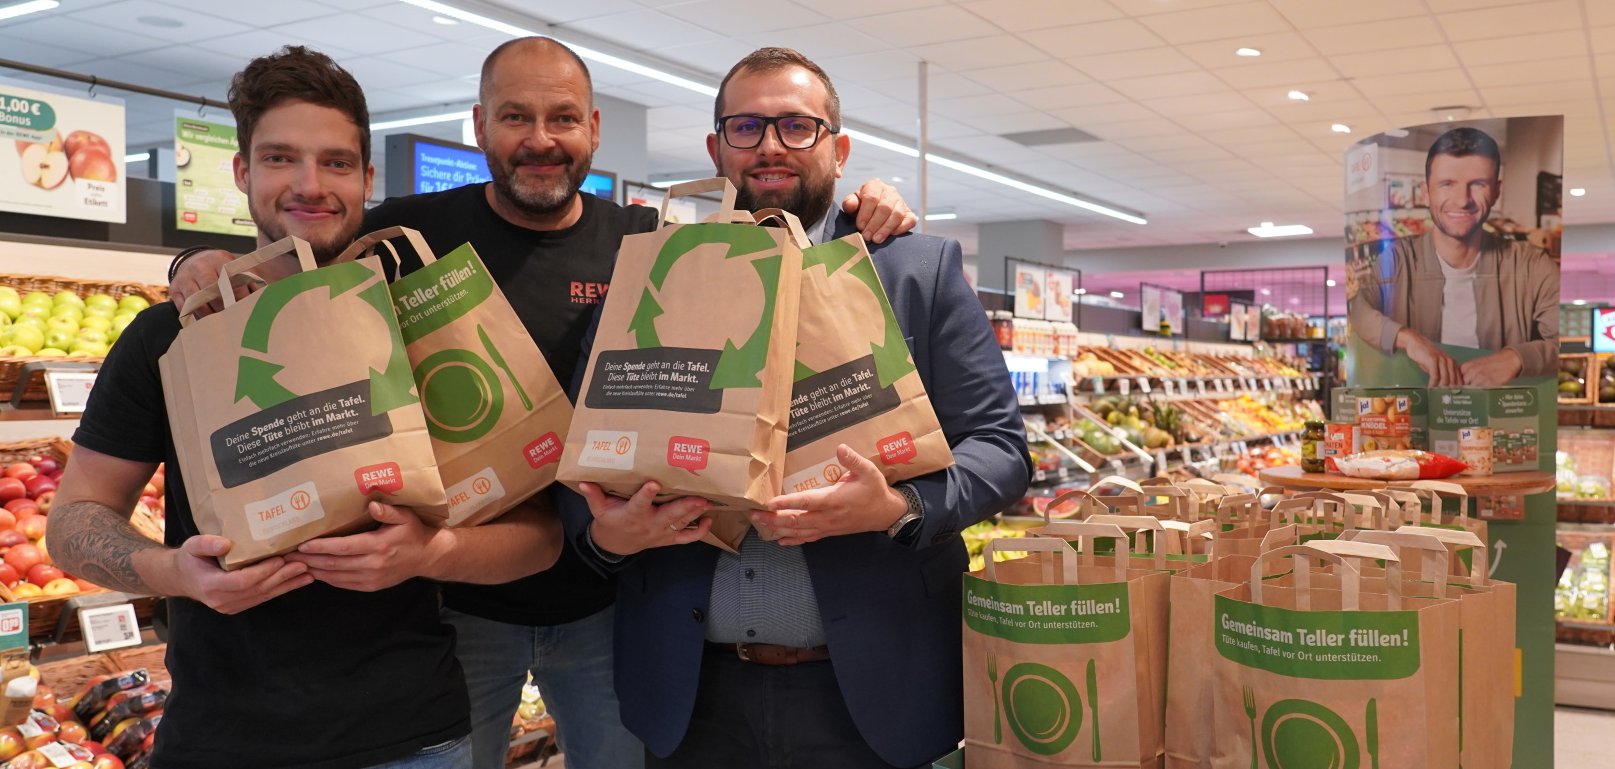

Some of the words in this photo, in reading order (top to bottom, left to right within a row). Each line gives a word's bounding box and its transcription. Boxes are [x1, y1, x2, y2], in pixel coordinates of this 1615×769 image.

[0, 111, 32, 126] Bonus
[421, 165, 452, 181] Sichere
[453, 171, 464, 183] dir
[399, 285, 439, 310] Teller
[440, 260, 476, 291] füllen!
[410, 313, 424, 323] Ort
[424, 290, 468, 316] unterstützen.
[605, 362, 622, 370] Deine
[623, 362, 646, 372] Spende
[646, 360, 660, 372] geht
[672, 360, 684, 370] die
[688, 361, 710, 372] Tafel.
[608, 372, 624, 381] Diese
[626, 372, 640, 380] Tüte
[640, 371, 658, 380] bleibt
[658, 371, 669, 380] im
[670, 372, 698, 383] Markt.
[810, 387, 828, 400] geht
[829, 382, 839, 392] an
[840, 377, 852, 387] die
[852, 369, 874, 382] Tafel.
[790, 406, 809, 418] Tüte
[809, 396, 832, 411] bleibt
[832, 393, 844, 402] im
[844, 382, 871, 398] Markt.
[226, 432, 250, 447] Deine
[251, 418, 284, 436] Spende
[286, 410, 307, 424] geht
[309, 407, 320, 416] an
[323, 402, 337, 412] die
[338, 395, 366, 408] Tafel.
[237, 439, 261, 454] Diese
[262, 430, 283, 443] Tüte
[284, 421, 310, 435] bleibt
[311, 418, 324, 426] im
[326, 409, 359, 423] Markt.
[317, 428, 353, 441] rewe.de/tafel
[530, 438, 555, 458] REWE
[543, 446, 558, 458] Markt
[592, 440, 611, 450] TAFEL
[674, 442, 703, 454] REWE
[882, 437, 909, 453] REWE
[897, 447, 911, 457] Markt
[362, 468, 395, 481] REWE
[380, 477, 396, 486] Markt
[794, 477, 820, 492] TAFEL
[258, 505, 286, 521] TAFEL
[967, 590, 1024, 615] Gemeinsam
[1026, 600, 1067, 616] Teller
[1070, 598, 1120, 616] füllen!
[1000, 617, 1013, 627] Tafel
[1028, 620, 1040, 629] Ort
[1043, 620, 1098, 629] unterstützen.
[1221, 613, 1293, 645] Gemeinsam
[1296, 628, 1345, 646] Teller
[1349, 628, 1409, 646] füllen!
[1222, 634, 1236, 646] Tüte
[1237, 638, 1261, 654] kaufen,
[1262, 645, 1280, 657] Tafel
[1282, 650, 1295, 659] vor
[1297, 651, 1312, 661] Ort
[1315, 653, 1382, 662] unterstützen.
